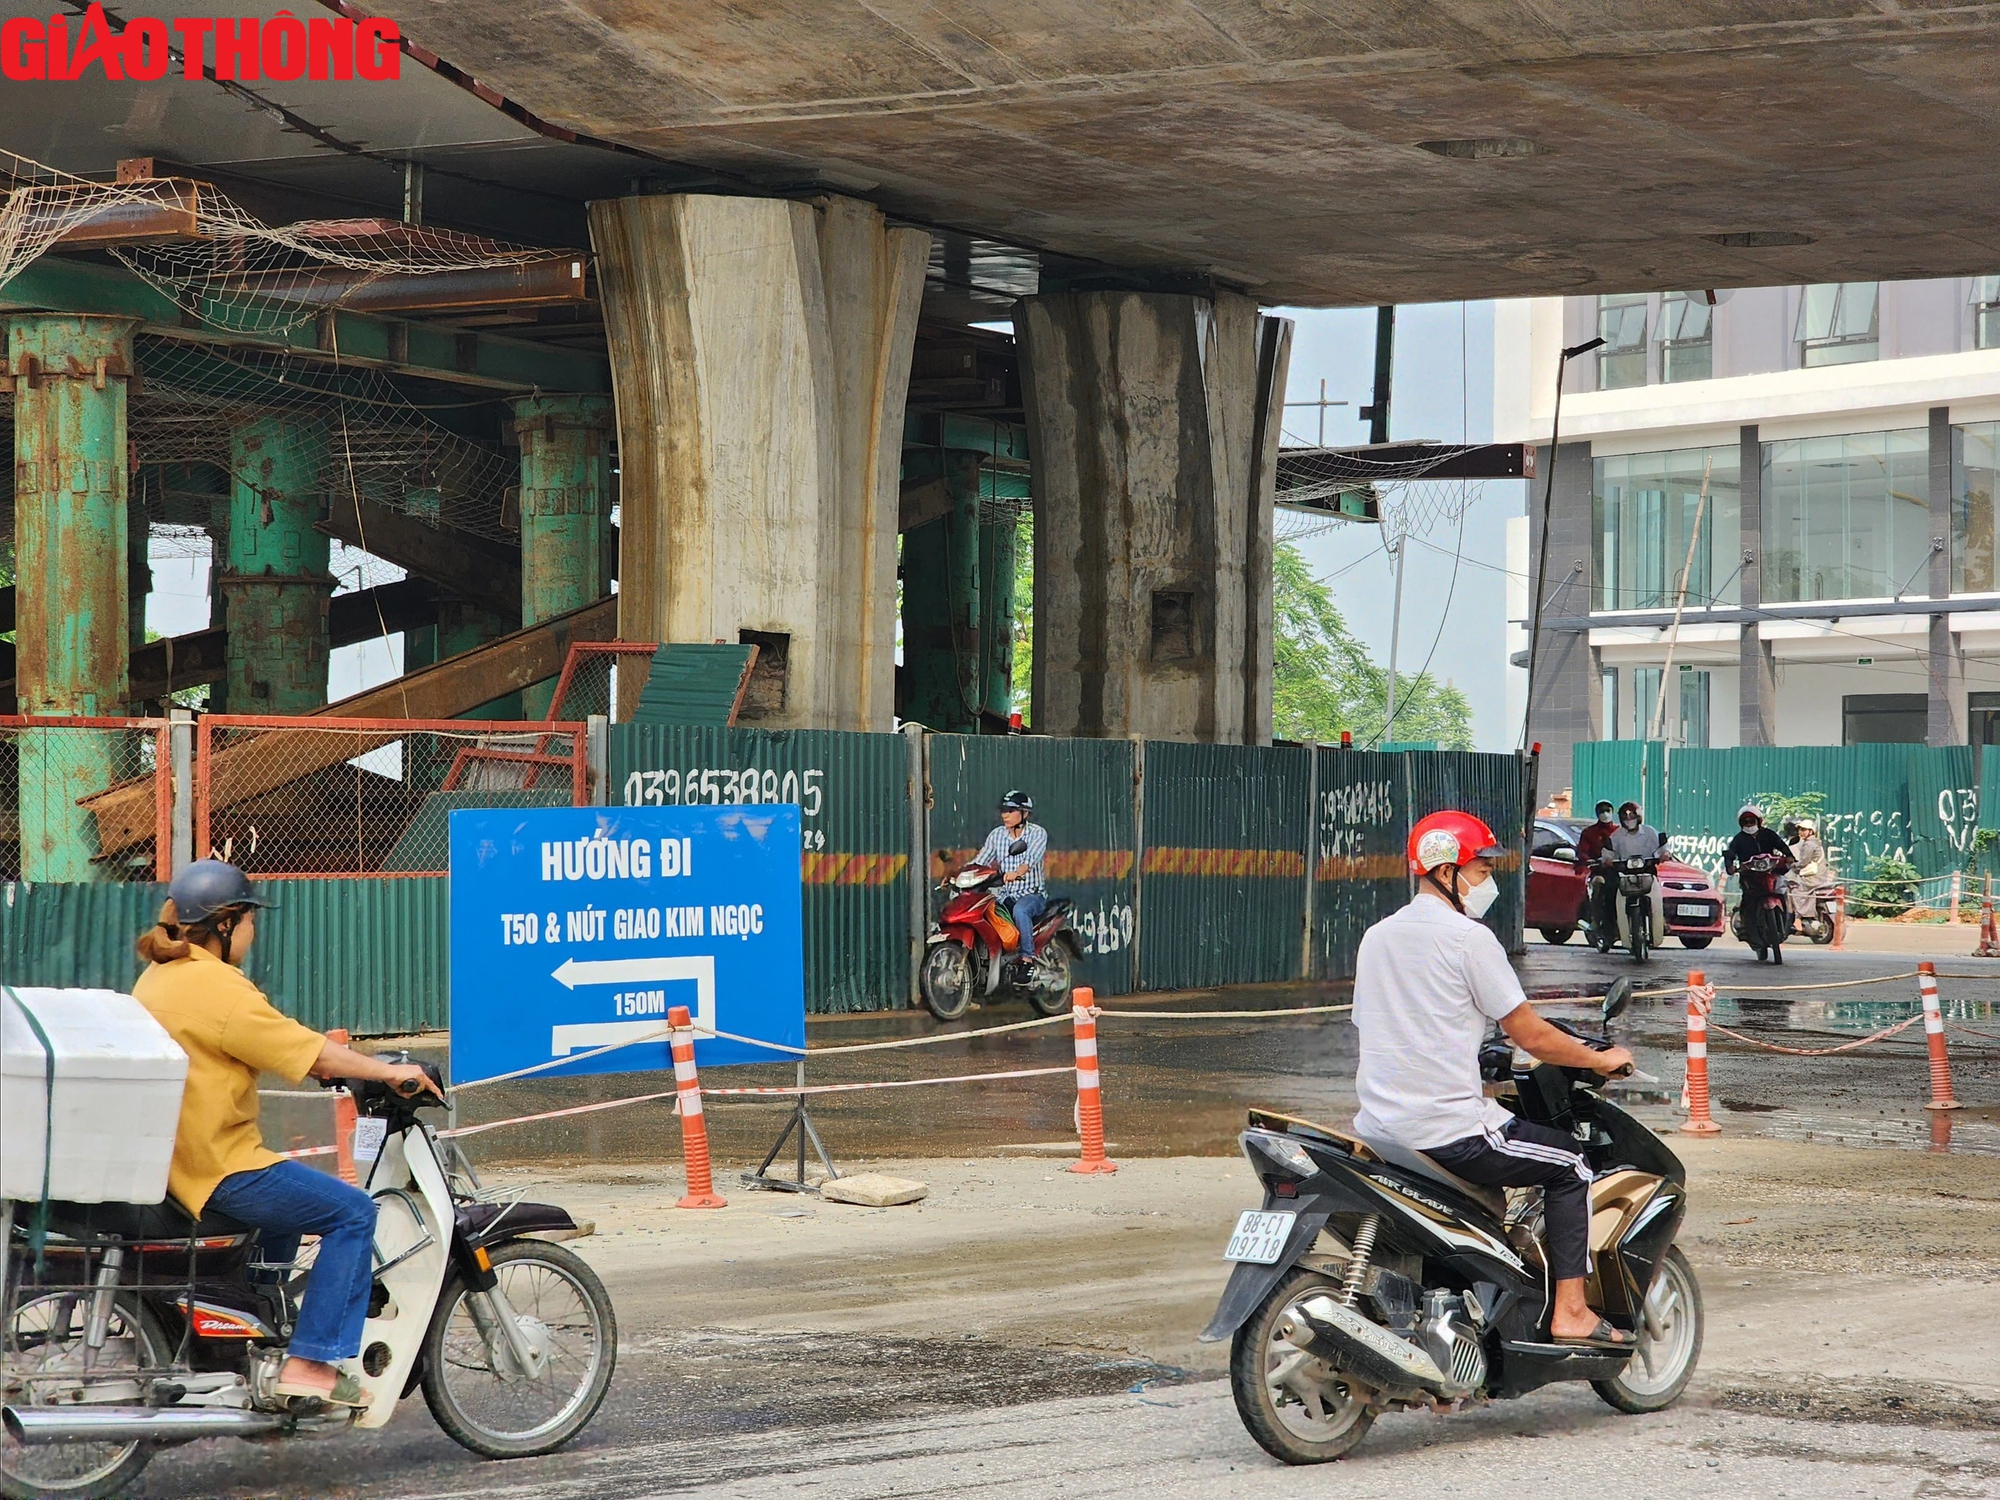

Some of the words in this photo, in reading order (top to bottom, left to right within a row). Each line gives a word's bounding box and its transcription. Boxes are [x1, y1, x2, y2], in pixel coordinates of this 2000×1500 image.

[541, 828, 651, 881] HƯỚNG
[659, 837, 692, 877] ĐI
[501, 912, 539, 945] T50
[544, 912, 561, 943] &
[567, 904, 607, 942] NÚT
[614, 907, 660, 940] GIAO
[665, 906, 704, 938] KIM
[710, 904, 763, 941] NGỌC
[613, 989, 665, 1016] 150M
[1369, 1173, 1401, 1192] AIR
[1401, 1187, 1455, 1216] BLADE
[1228, 1236, 1281, 1260] 097.18
